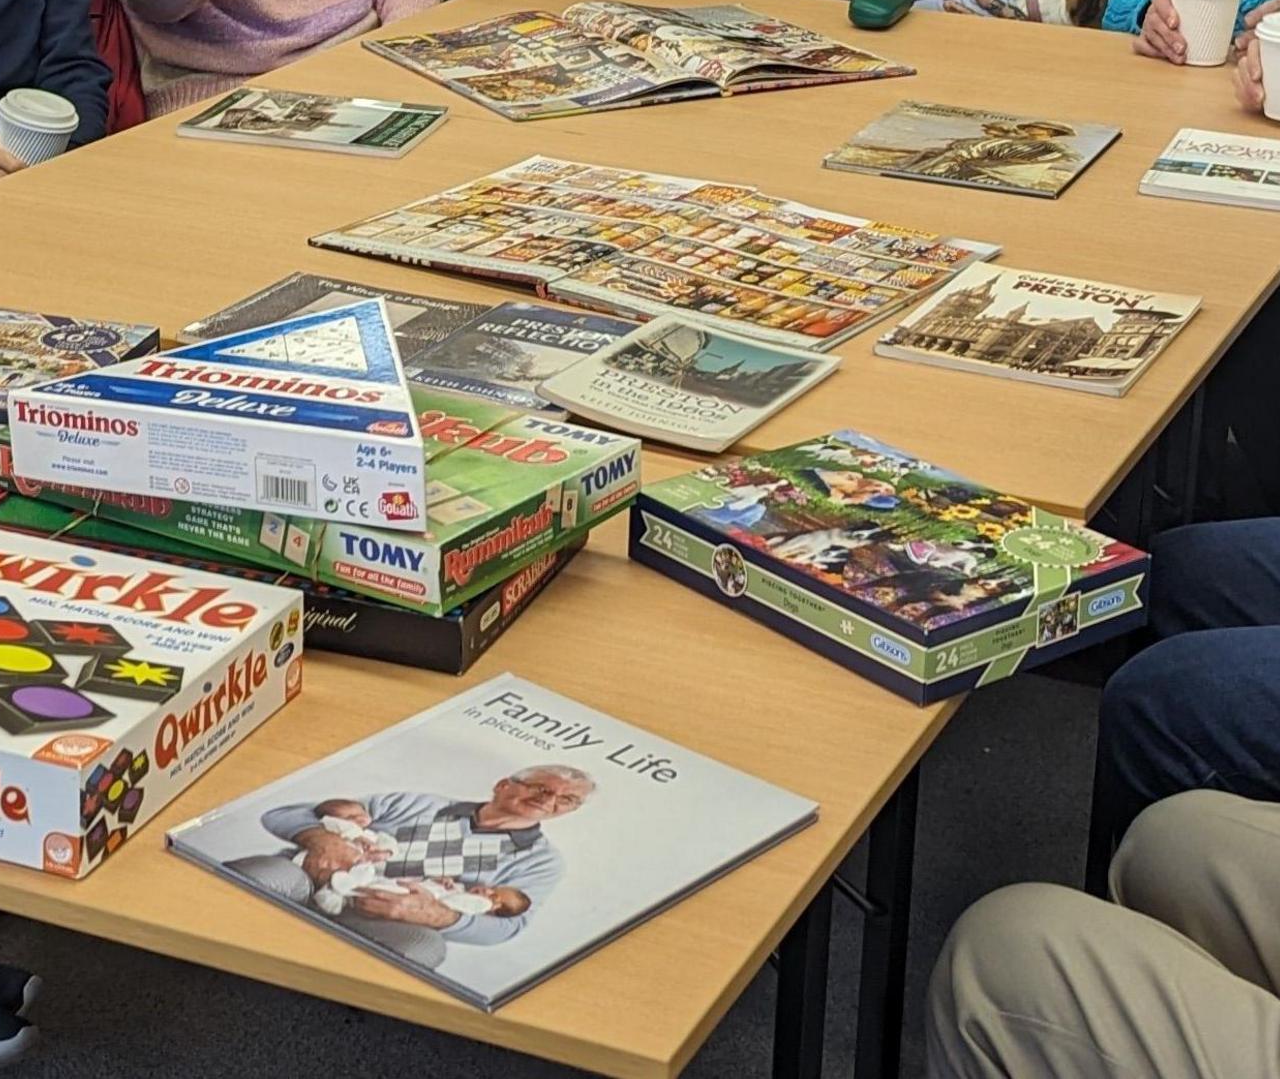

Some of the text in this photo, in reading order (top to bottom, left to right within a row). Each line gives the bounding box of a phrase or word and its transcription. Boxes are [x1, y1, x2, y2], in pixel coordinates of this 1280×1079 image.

[319, 279, 460, 311] The Change
[1012, 280, 1140, 309] PRESTON
[1018, 274, 1129, 296] Golden Years
[510, 317, 618, 344] PRESTON
[135, 357, 386, 404] Triominos
[414, 373, 460, 390] KEITH
[597, 366, 744, 414] PRESTON
[170, 388, 297, 418] Deluxe
[578, 394, 701, 433] KEITH JOHNSON
[13, 399, 139, 438] Triominos
[57, 429, 101, 449] Deluxe
[524, 418, 620, 447] TOMY
[356, 444, 378, 457] Age
[356, 456, 418, 475] 2-4 Players
[581, 449, 636, 497] TOMY
[343, 476, 359, 486] UK
[343, 485, 360, 495] CA
[190, 505, 235, 523] STRATEGY
[378, 497, 418, 517] Goliath
[566, 497, 574, 511] 8
[177, 521, 250, 548] NEVER THE SAME
[184, 514, 242, 535] GAME THAT'S
[269, 521, 278, 535] 2
[294, 534, 302, 548] 4
[443, 500, 554, 587] Rummikub
[654, 527, 673, 550] 24
[339, 532, 425, 573] TOMY
[335, 564, 425, 595] Fun for all the family
[29, 596, 232, 644] MIX, MATCH, SCORE AND WIN!
[935, 647, 959, 673] 24
[155, 648, 268, 770] Qwirkle
[462, 704, 556, 754] in pictures
[483, 692, 680, 785] Family Life
